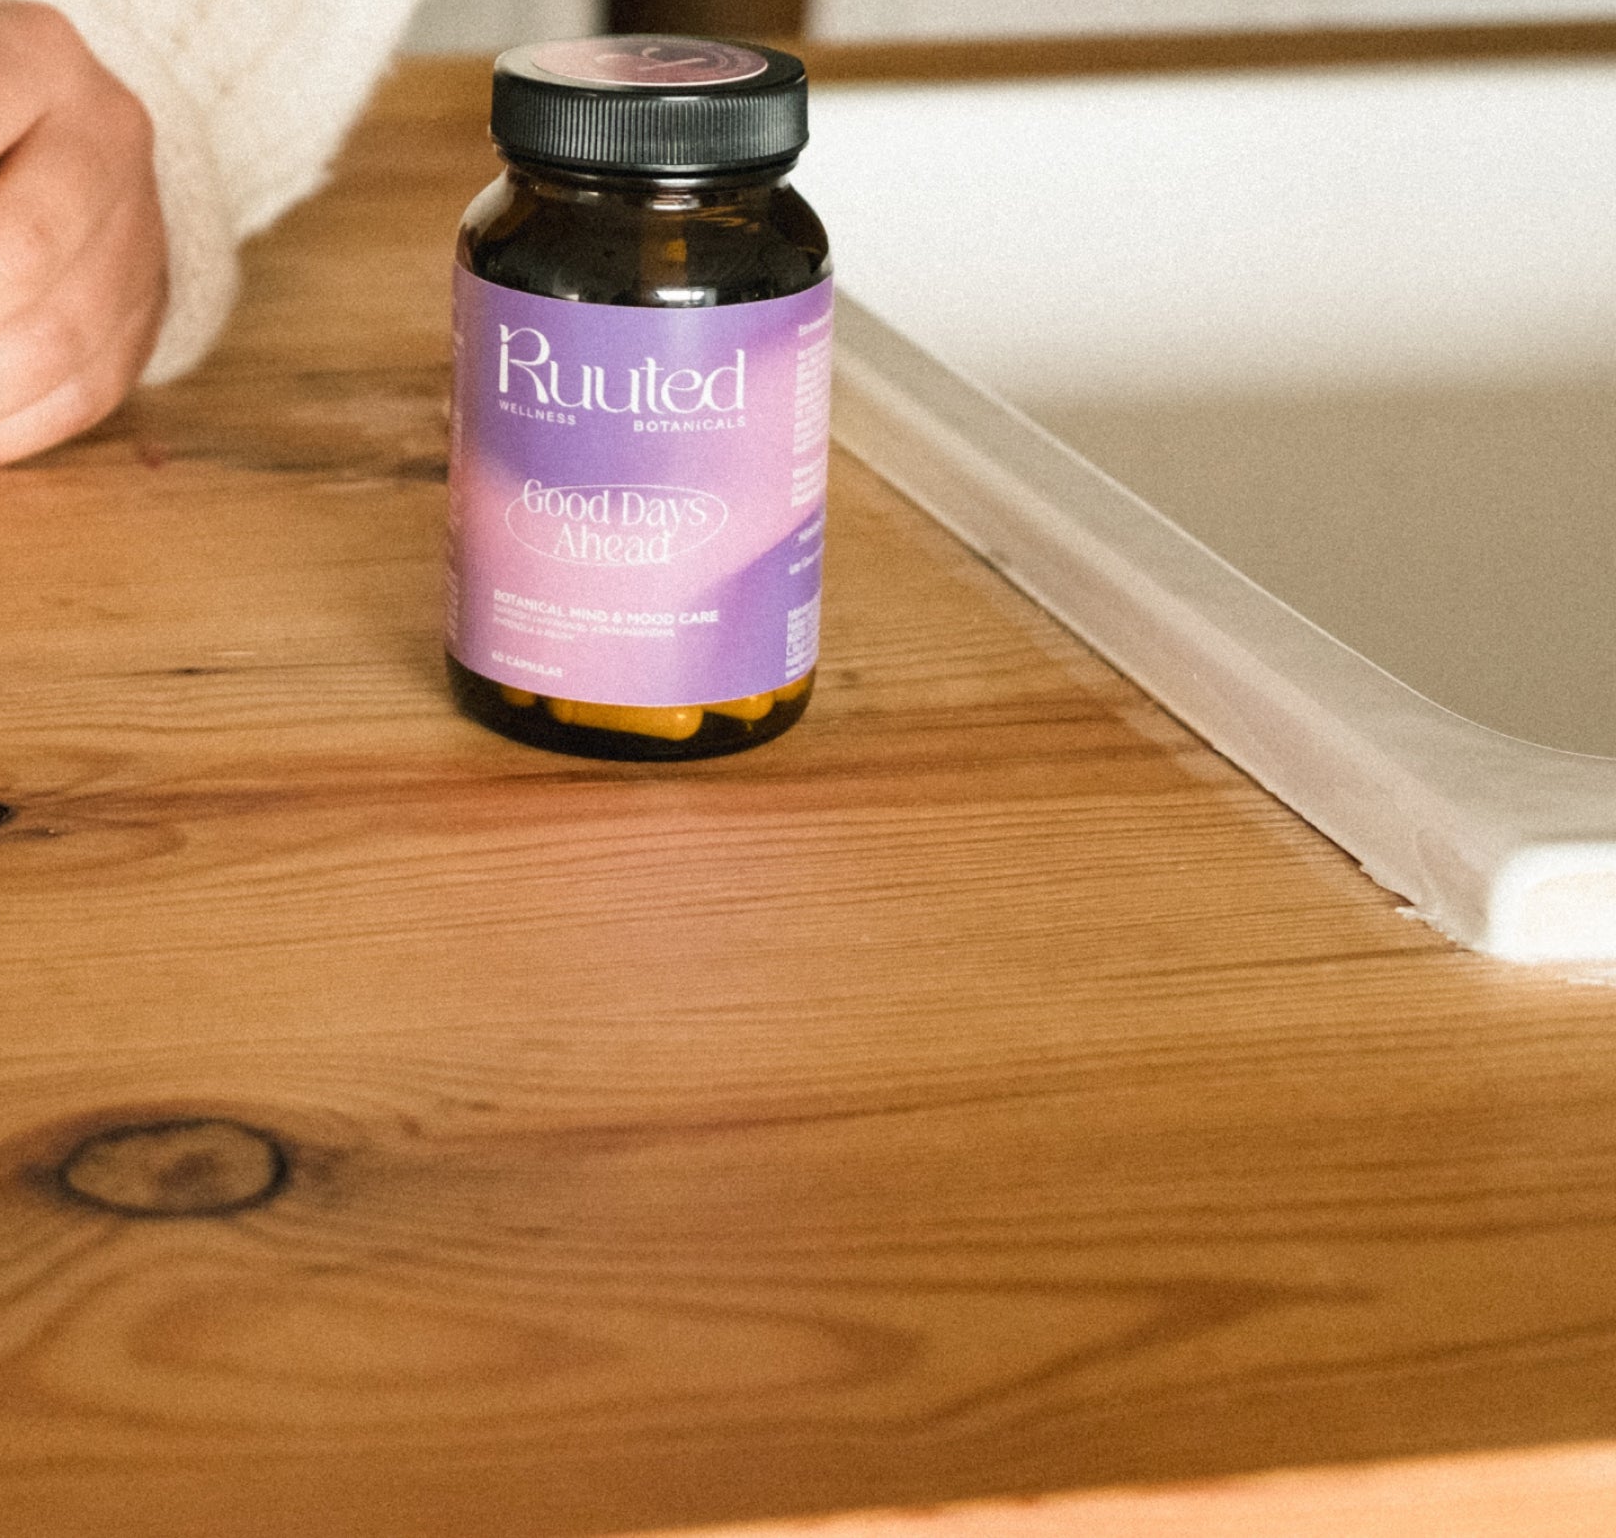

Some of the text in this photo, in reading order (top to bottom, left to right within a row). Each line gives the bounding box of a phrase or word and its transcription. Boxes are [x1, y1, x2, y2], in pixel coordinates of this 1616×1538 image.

[499, 323, 746, 415] Ruuted
[499, 399, 577, 426] WELLNESS
[633, 415, 747, 433] BOTANICALS
[523, 478, 708, 539] Good Days
[553, 522, 670, 564] Ahead
[493, 589, 566, 617] BOTANICAL
[569, 607, 609, 623] MIND
[611, 611, 623, 624] &
[626, 612, 676, 626] MOOD
[678, 610, 719, 625] CARE
